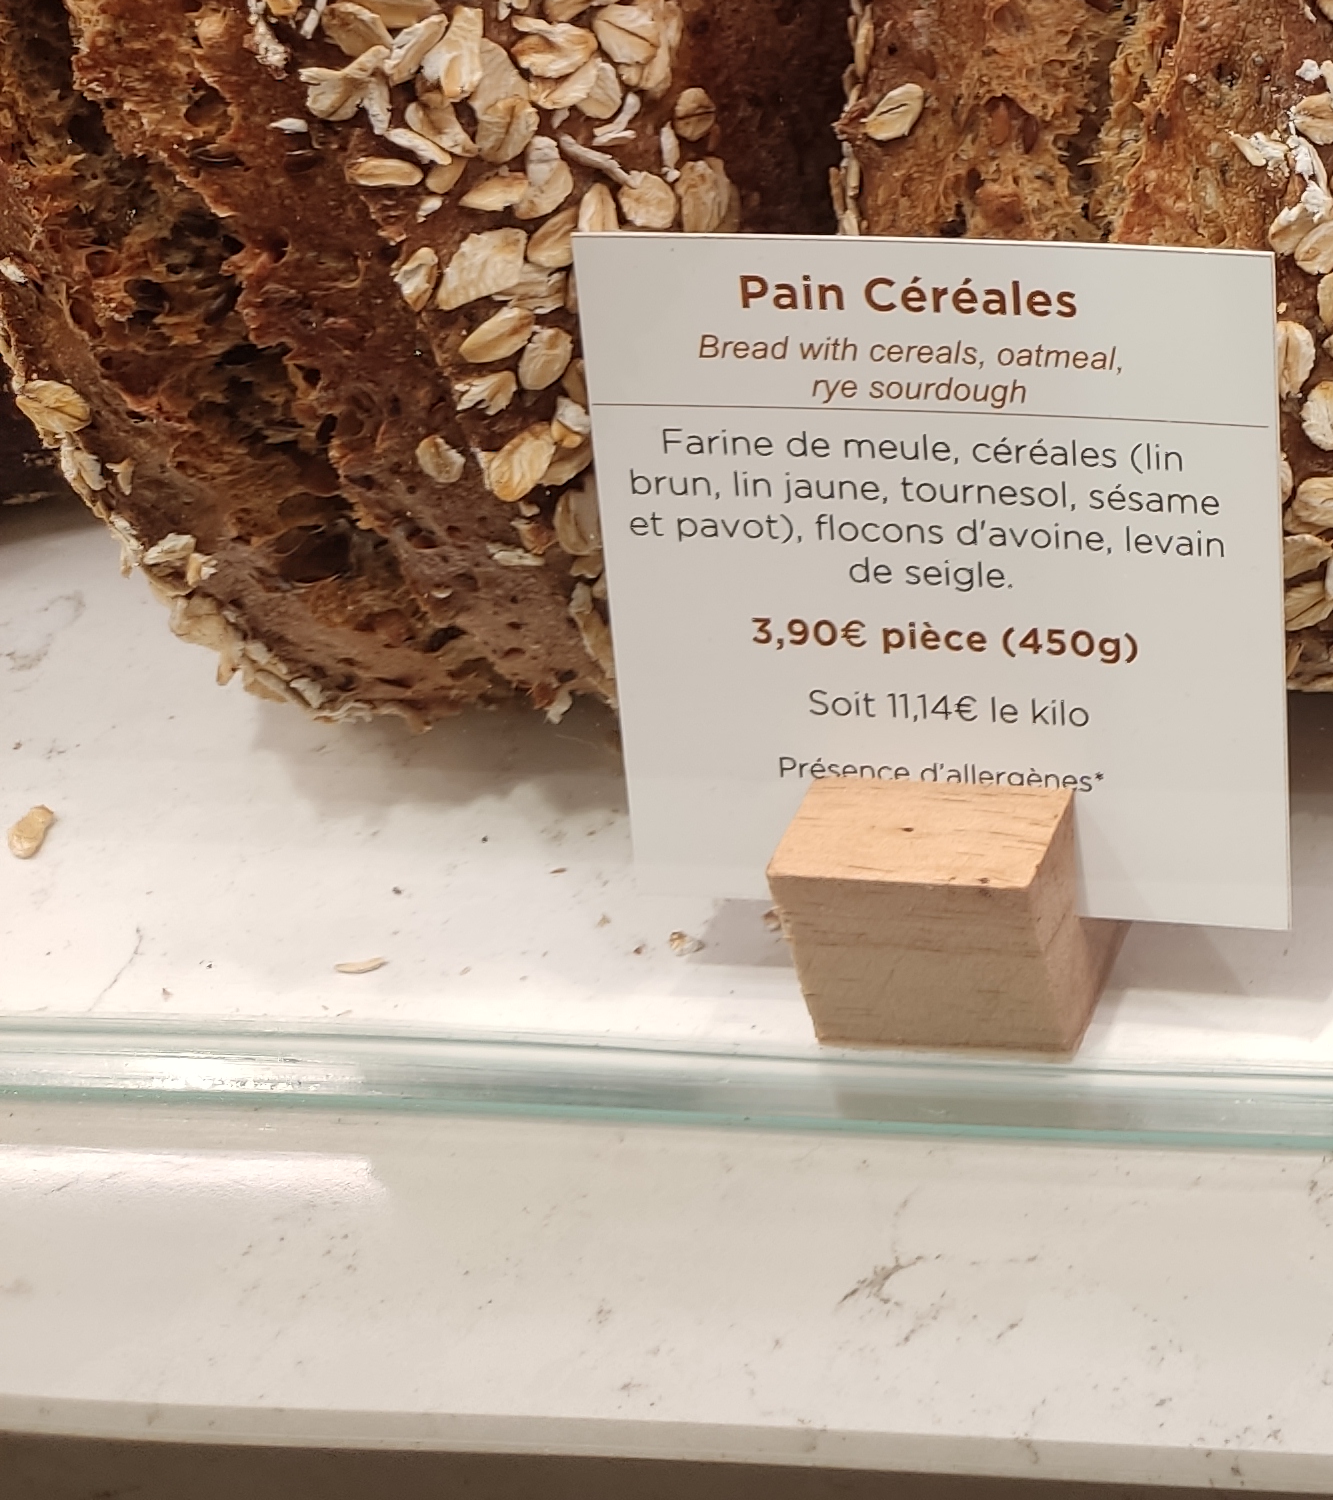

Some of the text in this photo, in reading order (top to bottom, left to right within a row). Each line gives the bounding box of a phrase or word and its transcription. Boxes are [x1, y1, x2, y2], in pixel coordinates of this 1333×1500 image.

[739, 274, 1078, 319] Pain Céréales
[698, 334, 1122, 376] Bread with cereals, oatmeal,
[811, 376, 1027, 410] rye sourdough
[662, 428, 1183, 475] Farine de meule, céréales (lin
[629, 467, 1220, 516] brun, lin jaune, tournesol, sésame
[629, 511, 1225, 558] et pavot), flocons d'avoine, levain
[848, 556, 1014, 593] de seigle.
[751, 617, 1139, 665] 3,90€ pièce (450g)
[808, 689, 1090, 728] Soit 11,14€ le kilo
[778, 756, 911, 781] Présence
